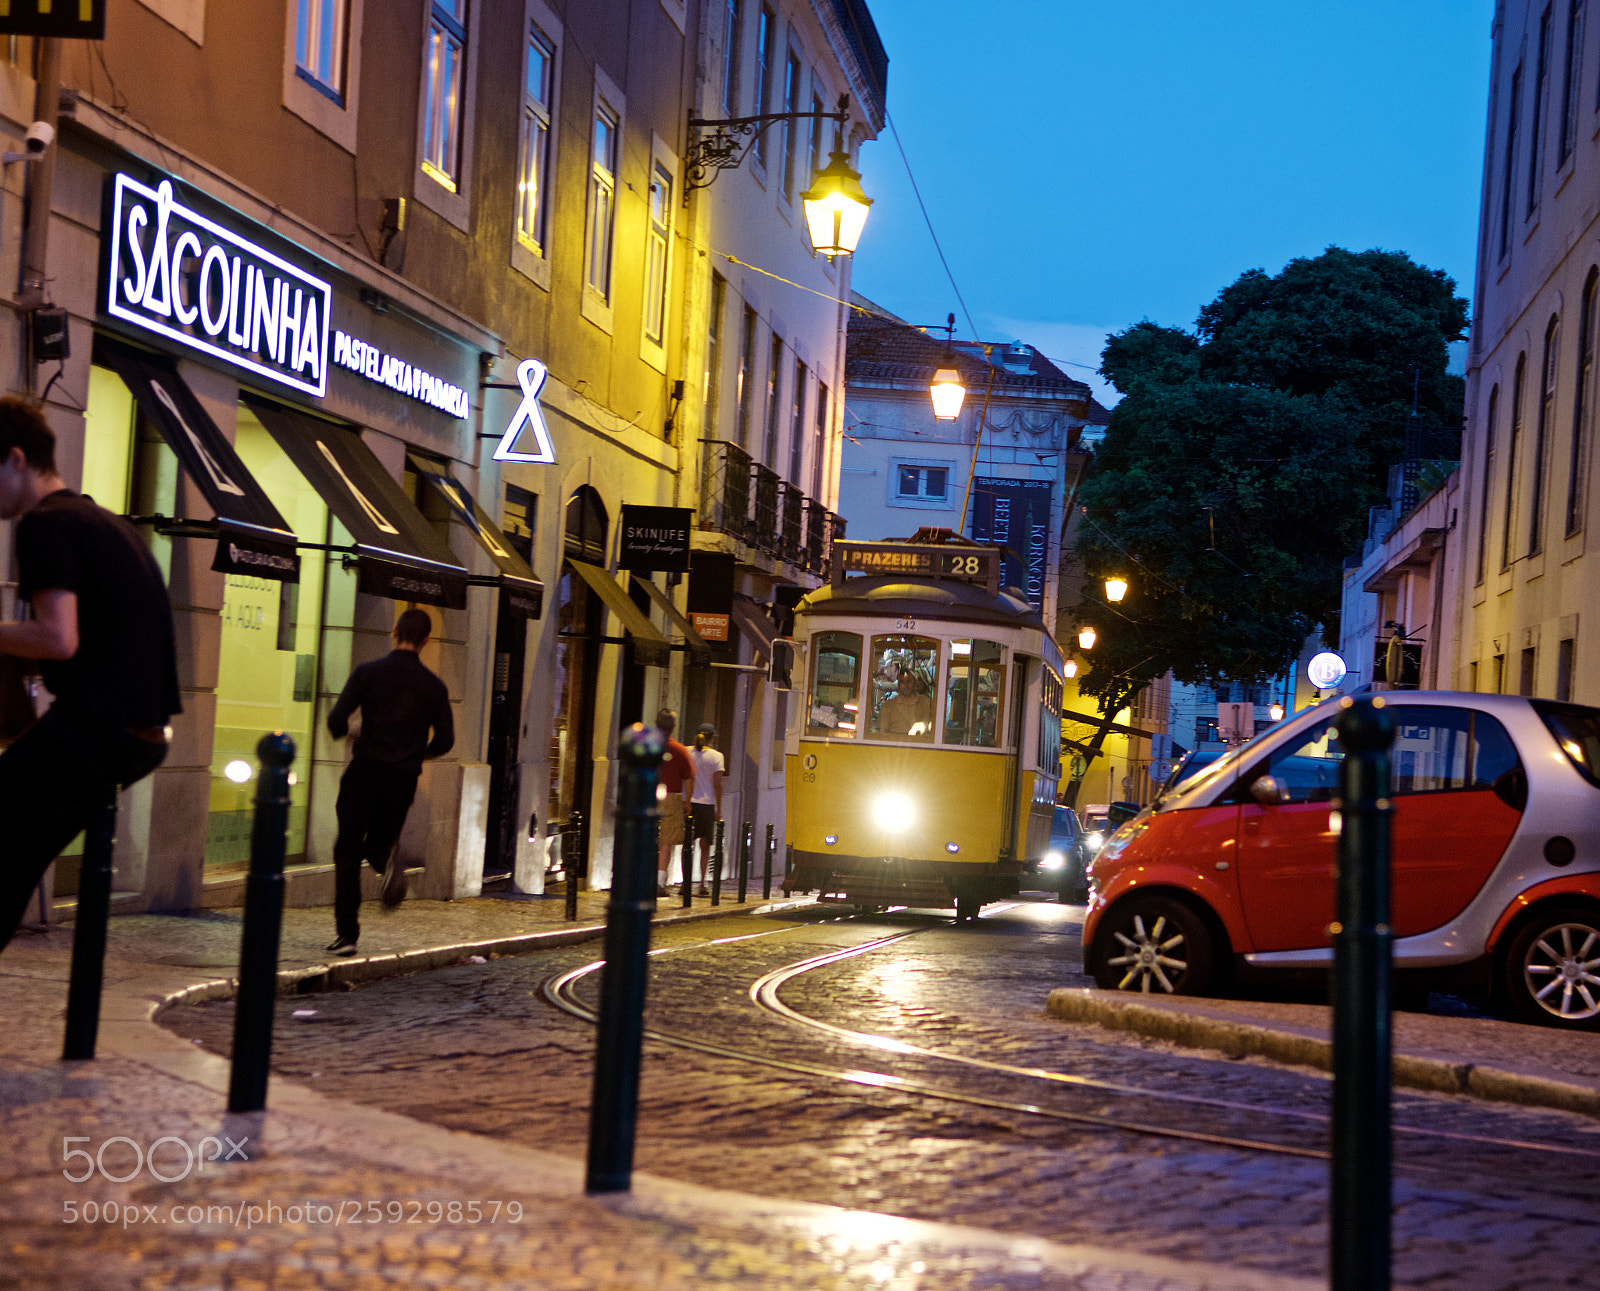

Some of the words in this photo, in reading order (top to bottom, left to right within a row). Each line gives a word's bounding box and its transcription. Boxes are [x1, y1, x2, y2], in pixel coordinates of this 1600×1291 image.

[122, 179, 320, 379] SACOLINHA
[333, 330, 413, 396] PASTELARIA
[419, 371, 469, 420] PADARIA
[979, 479, 1021, 488] TEMPORADA
[627, 526, 685, 543] SKINLIFE
[852, 551, 931, 567] PRAZERES
[951, 556, 979, 575] 28
[696, 616, 728, 627] BAIRRO
[896, 621, 917, 631] 542
[701, 628, 722, 638] ARTE
